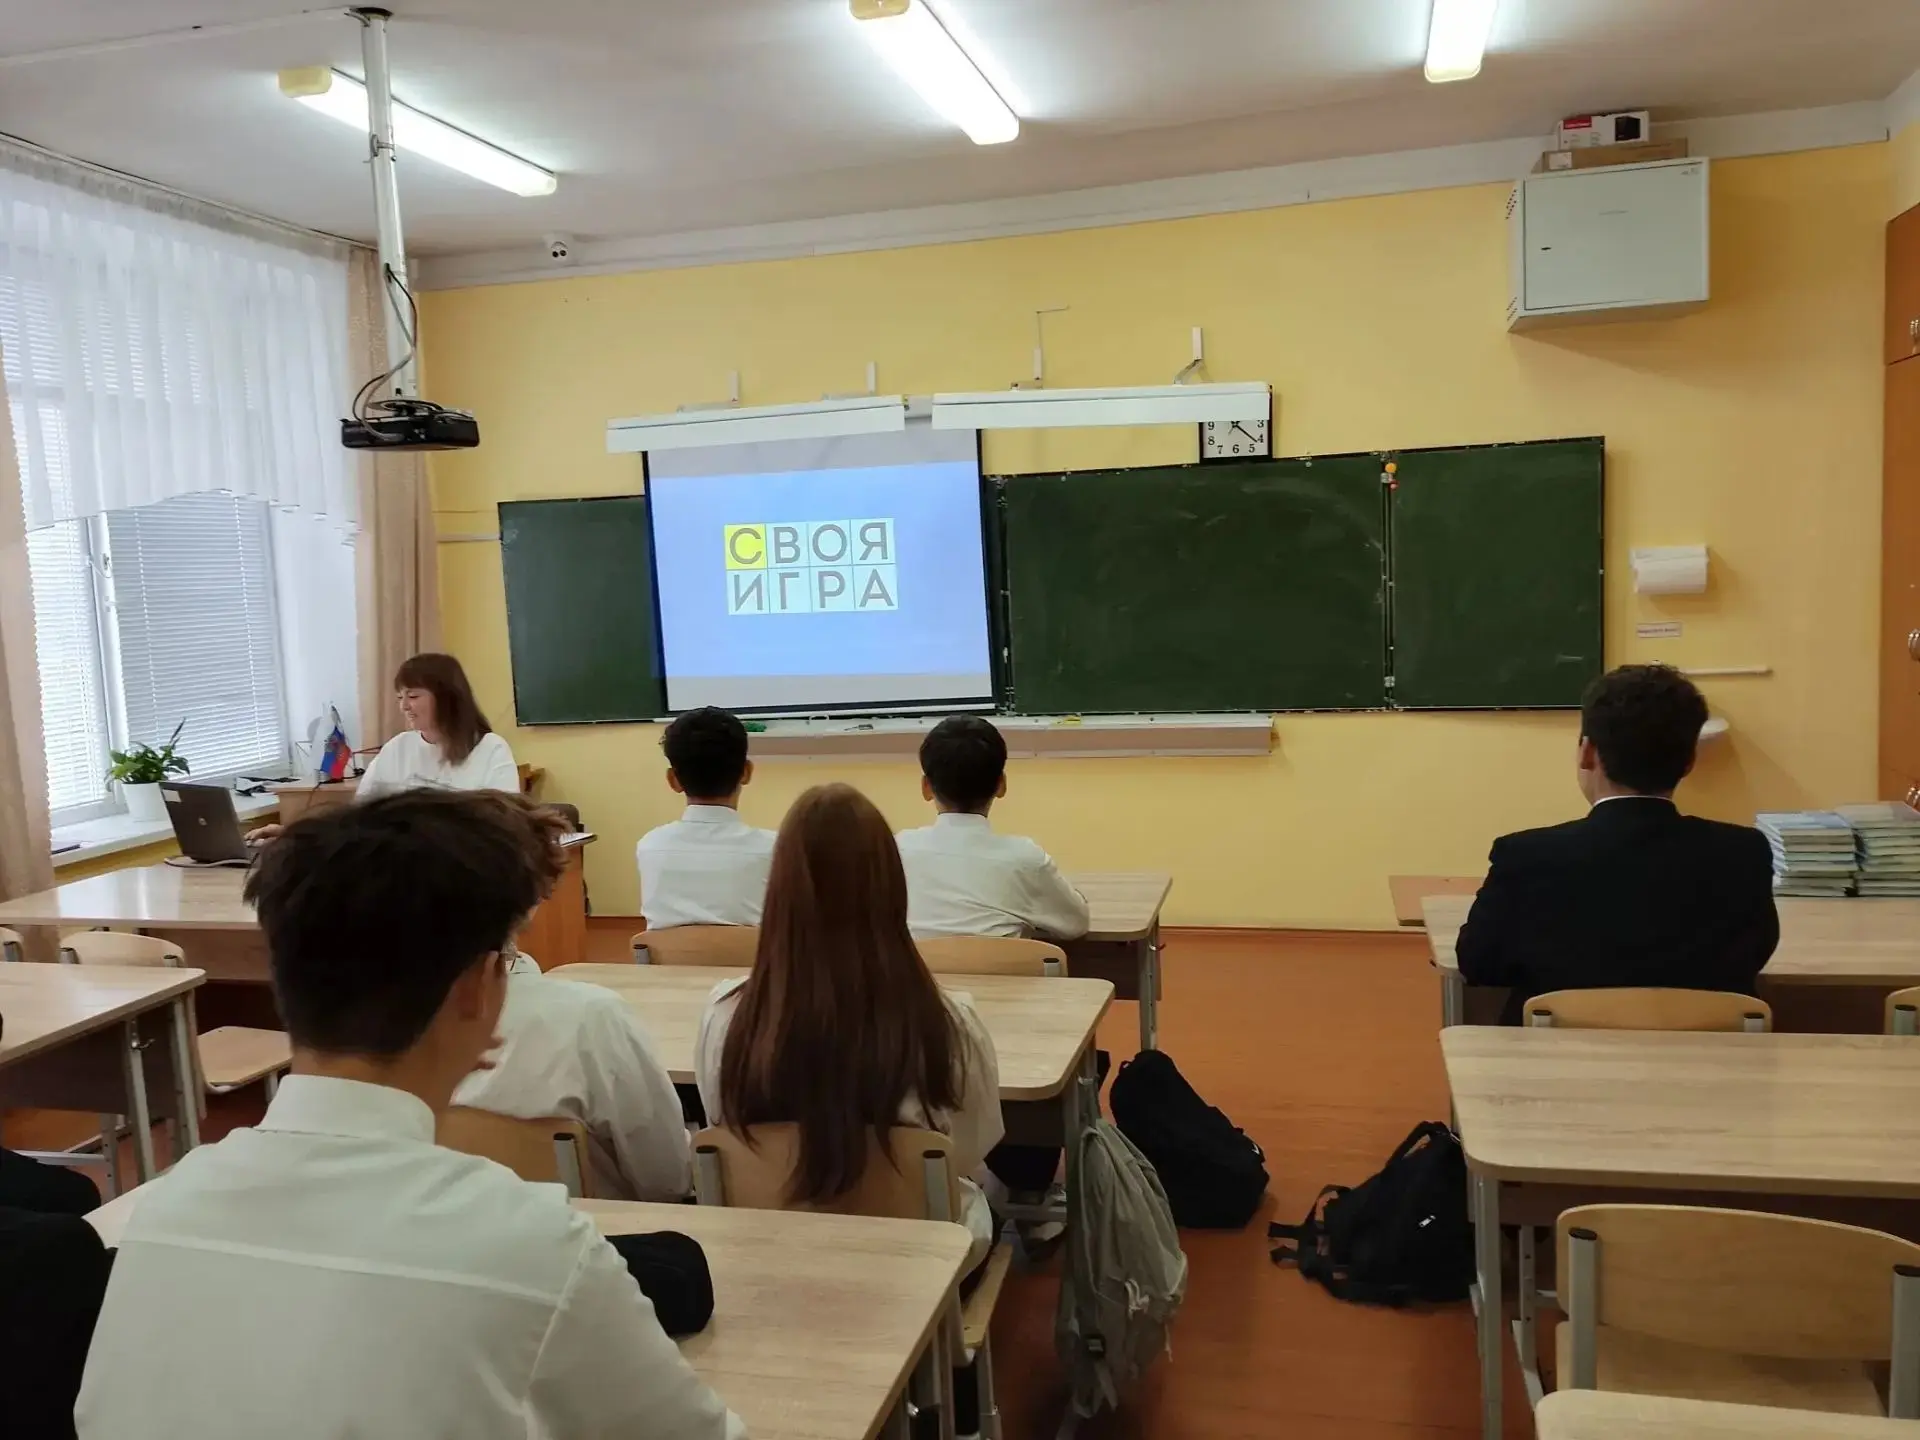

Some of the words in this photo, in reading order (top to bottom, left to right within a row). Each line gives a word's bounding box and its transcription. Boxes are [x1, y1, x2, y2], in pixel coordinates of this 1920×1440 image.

[1207, 421, 1215, 431] 9
[1207, 436, 1215, 446] 8
[1257, 434, 1264, 443] 4
[1216, 445, 1224, 455] 7
[1232, 444, 1240, 454] 6
[1248, 443, 1256, 453] 5
[729, 522, 888, 564] СВОЯ
[734, 568, 895, 612] ИГРА
